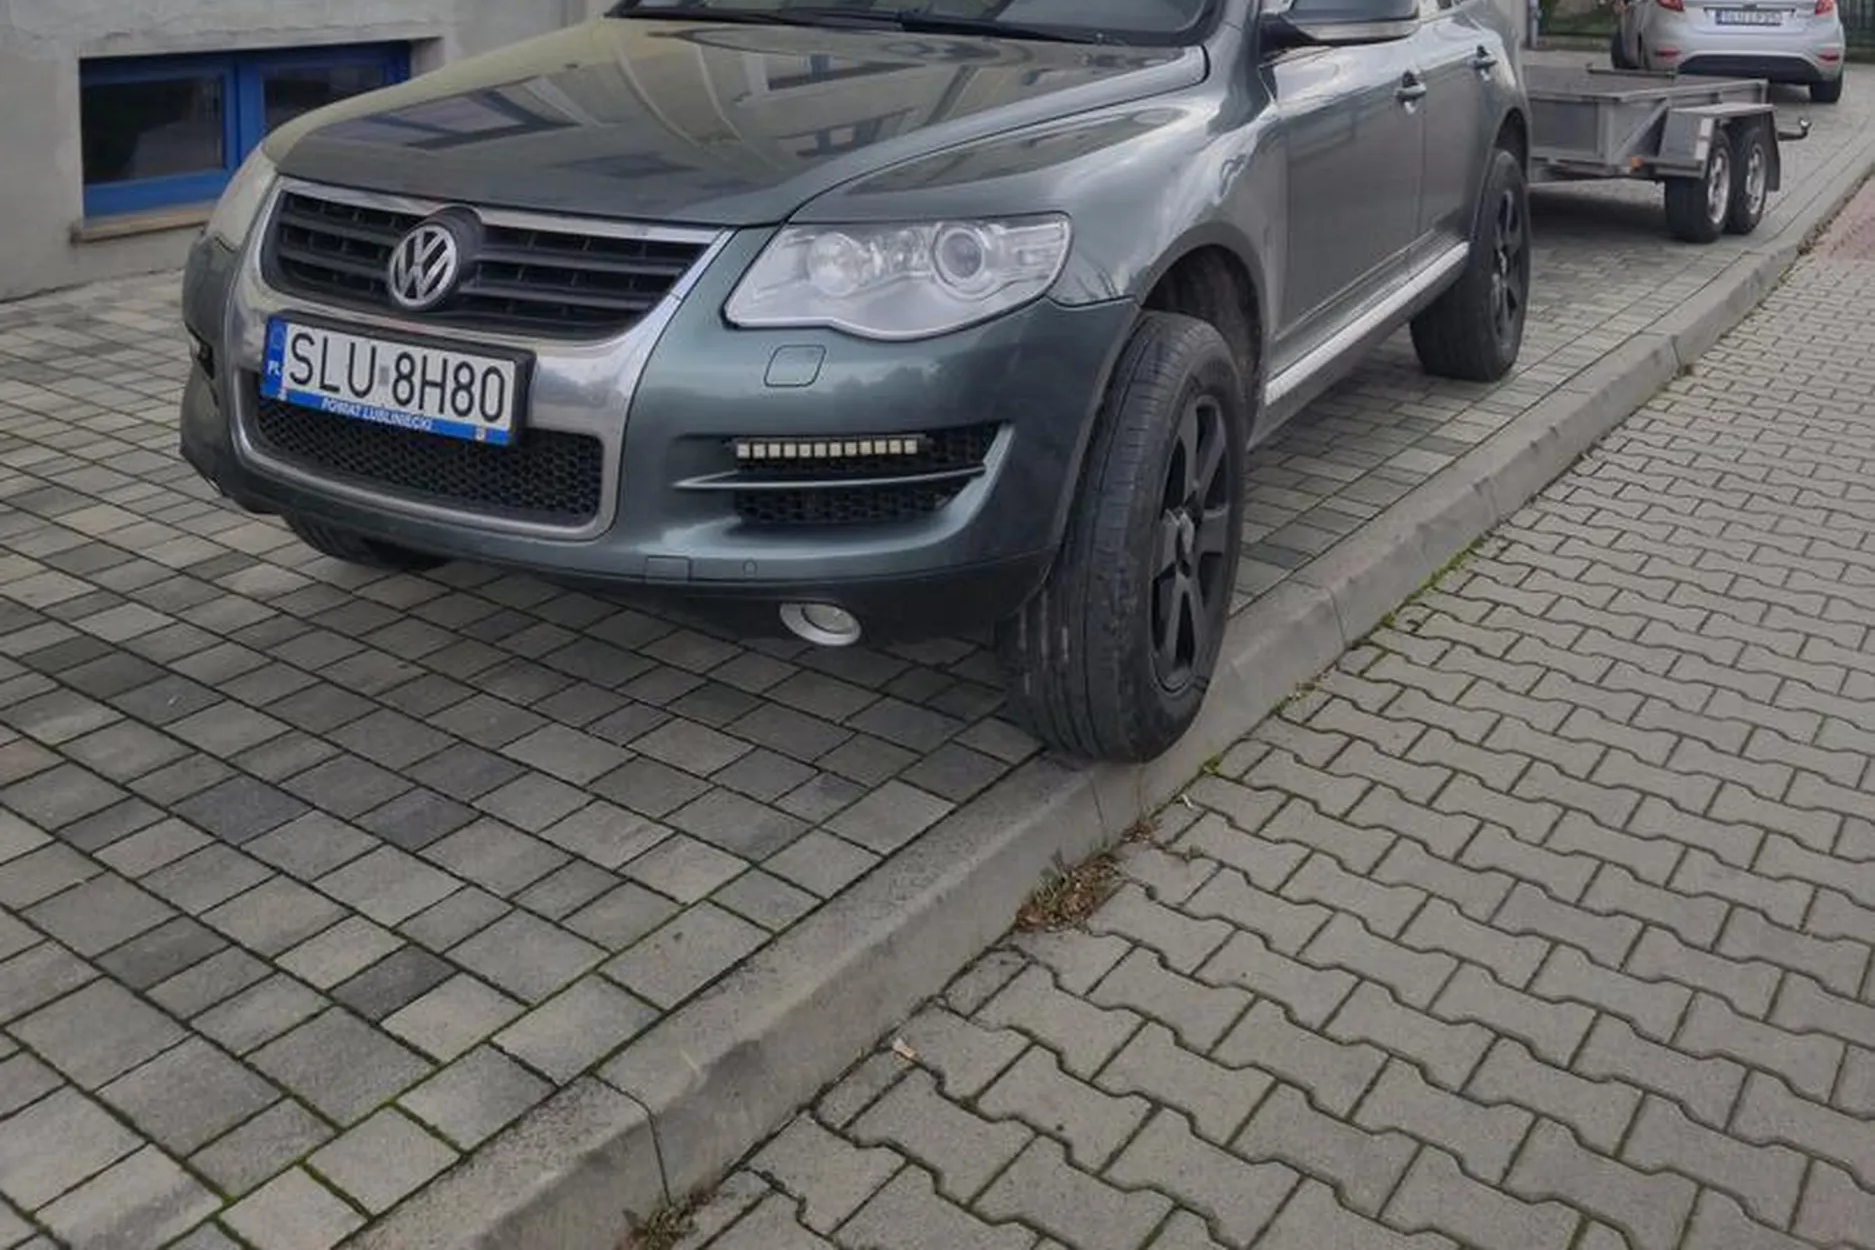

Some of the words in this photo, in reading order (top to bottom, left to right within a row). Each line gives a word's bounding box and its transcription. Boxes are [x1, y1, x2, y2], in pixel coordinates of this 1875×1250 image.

[267, 360, 281, 377] PL
[289, 331, 377, 399] SLU
[391, 351, 506, 423] 8H80
